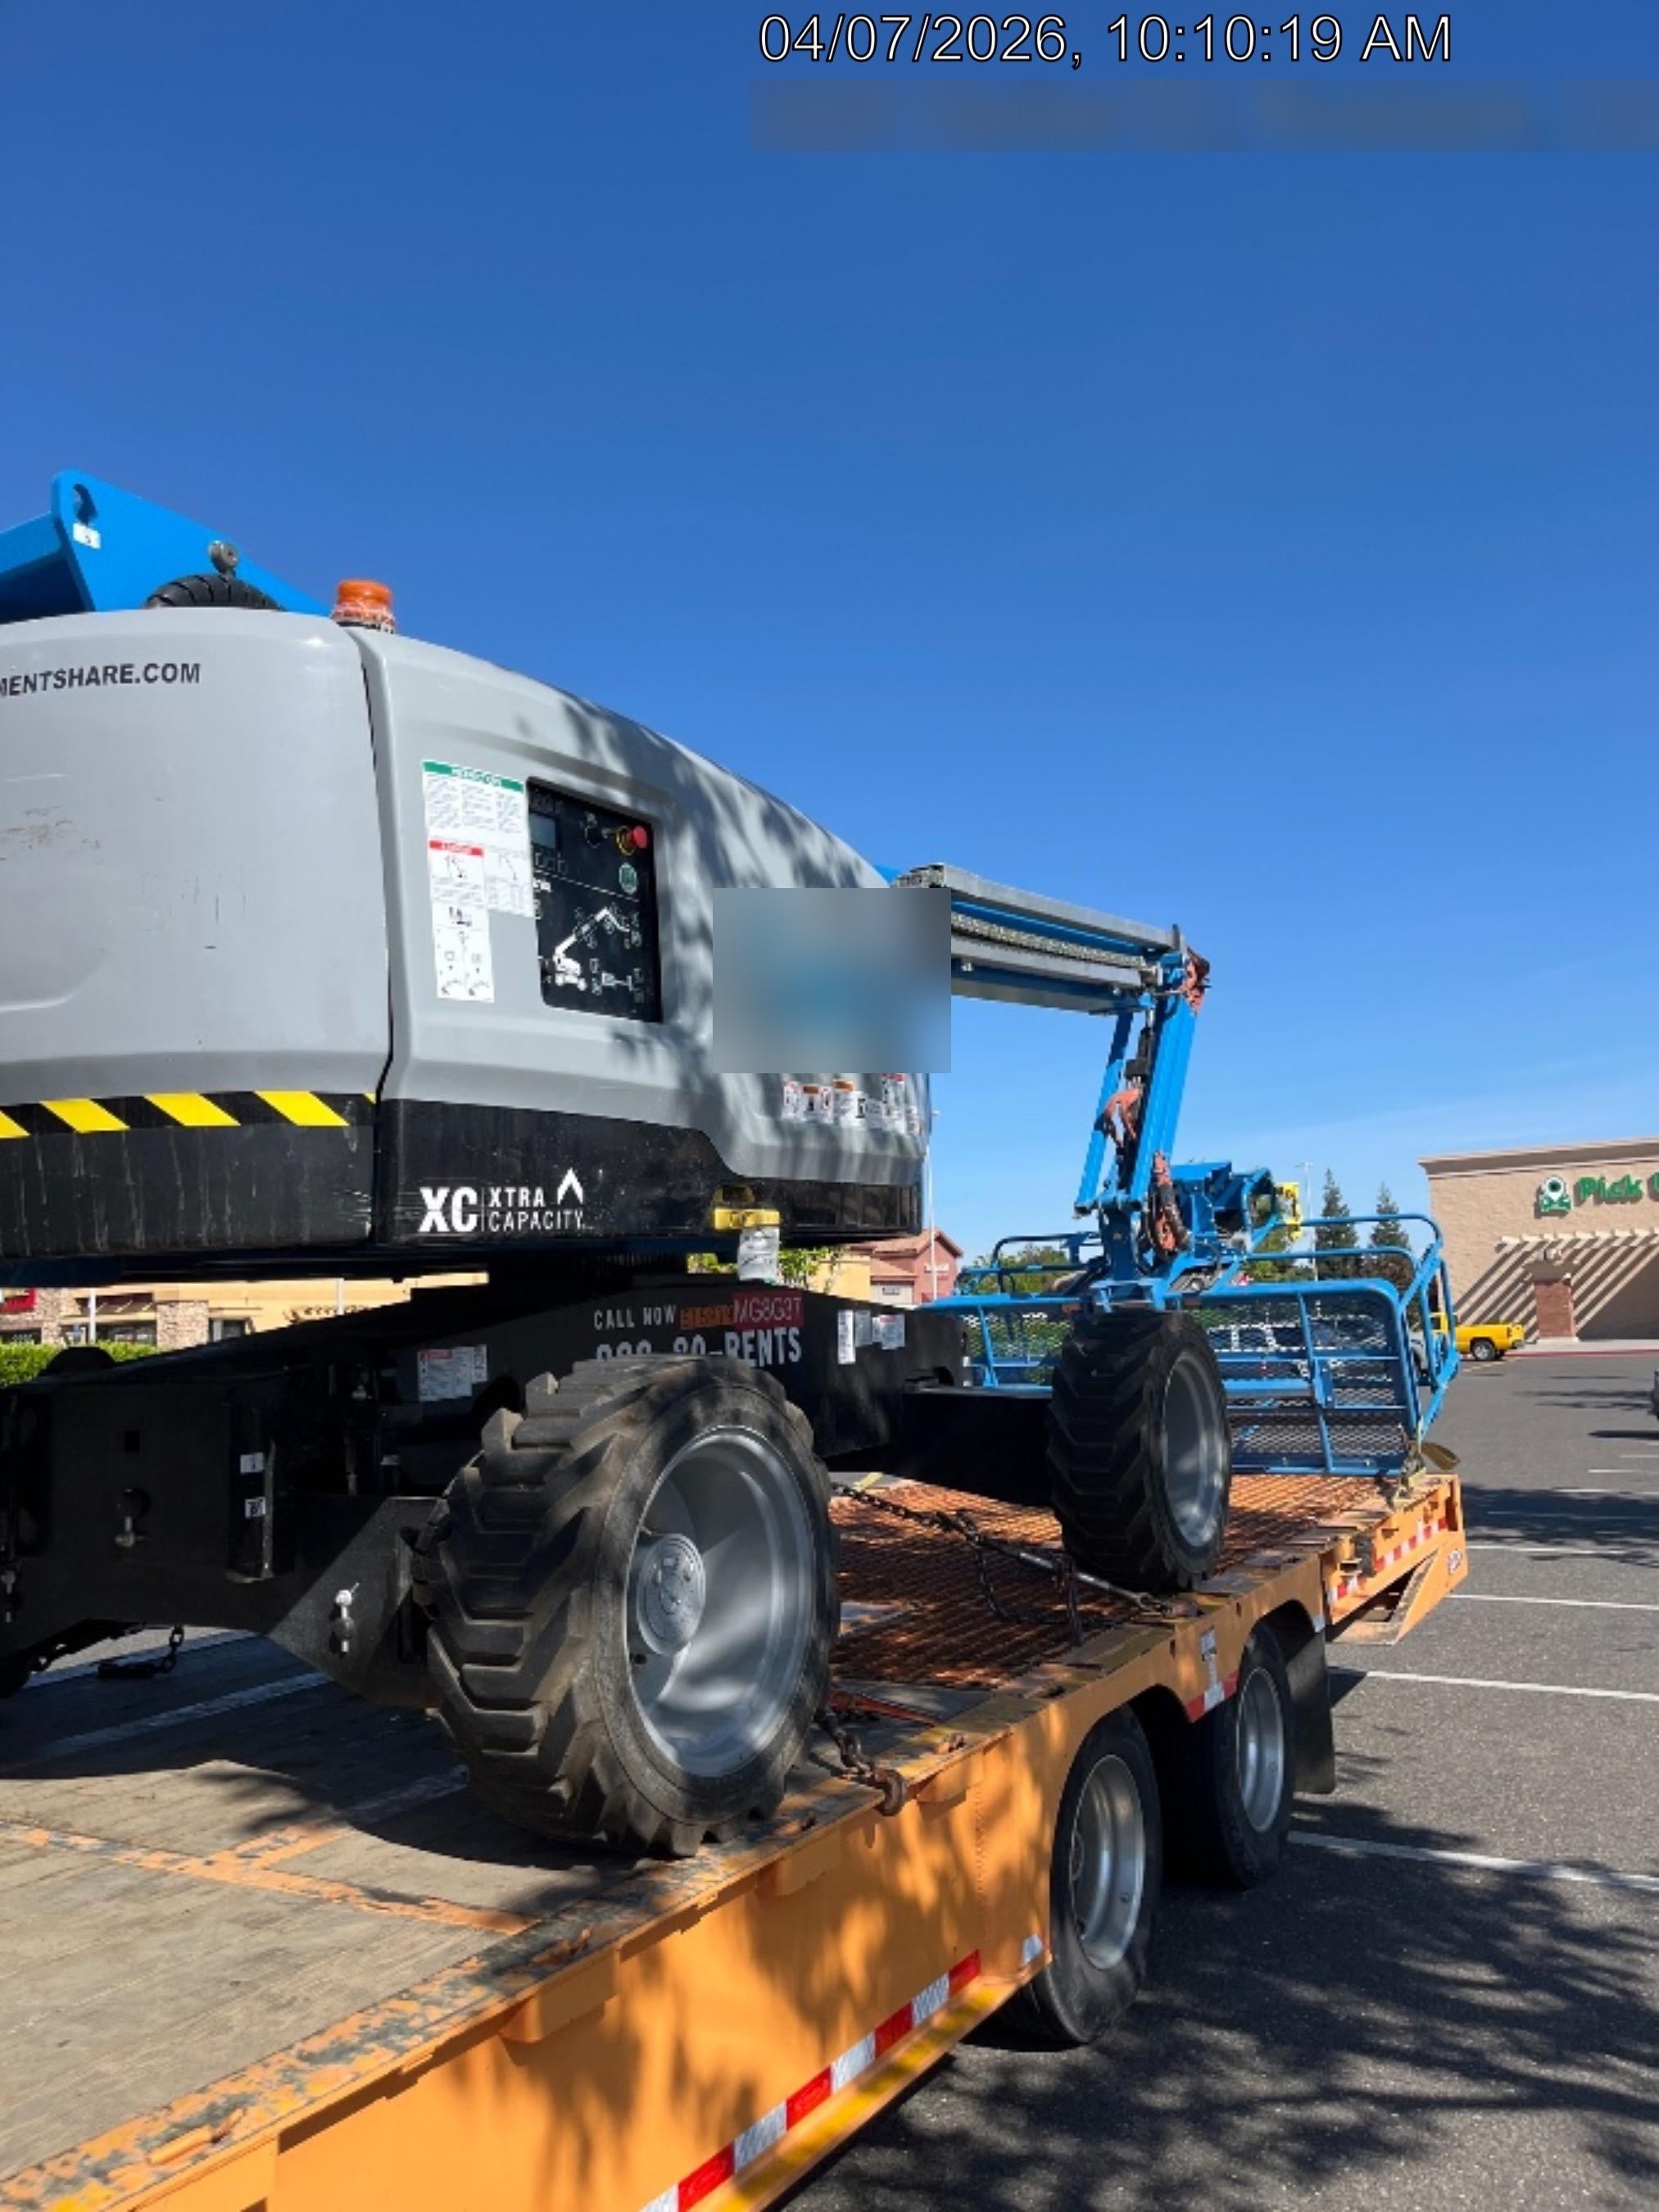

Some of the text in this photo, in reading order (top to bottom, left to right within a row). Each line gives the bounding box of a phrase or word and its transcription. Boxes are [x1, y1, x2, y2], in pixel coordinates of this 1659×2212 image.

[489, 1186, 546, 1208] XTRA
[1578, 1173, 1643, 1201] Pick
[418, 1186, 478, 1232] XC
[489, 1208, 583, 1232] CAPACITY
[594, 1309, 635, 1330] CALL
[643, 1303, 677, 1326] NOW
